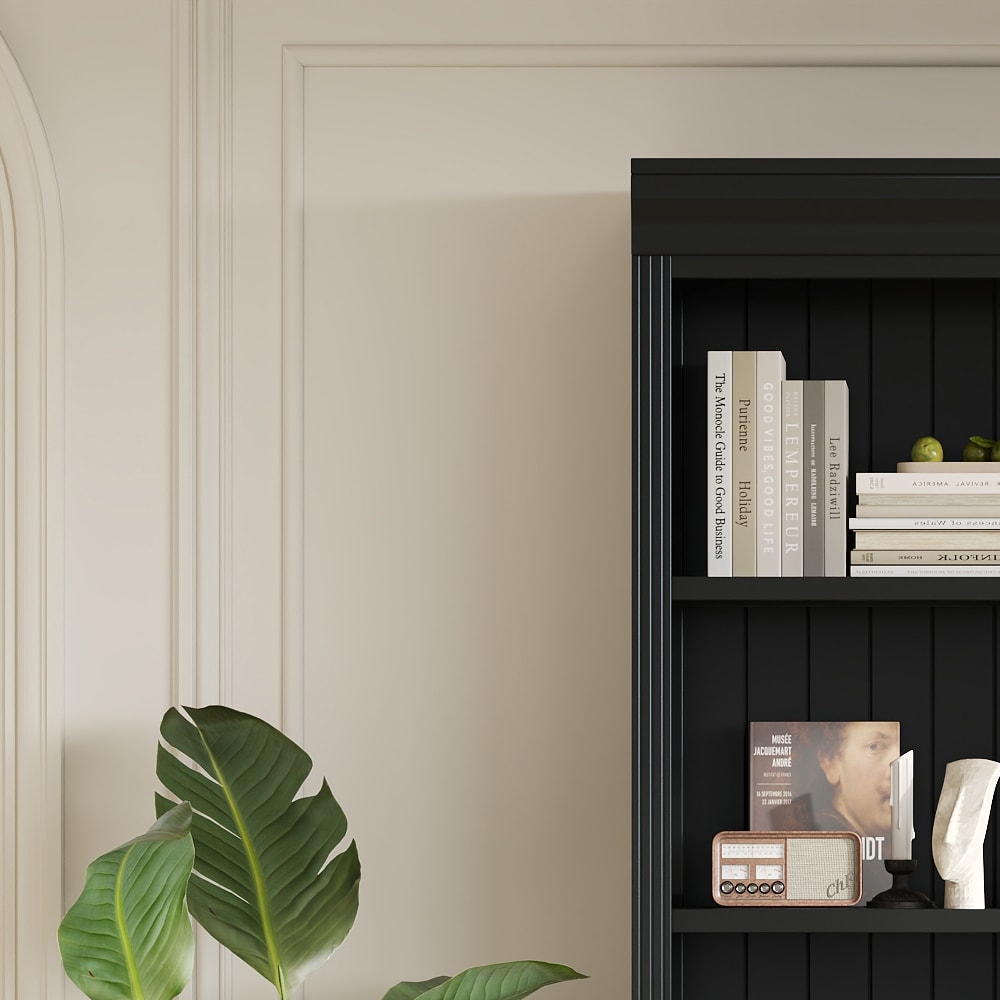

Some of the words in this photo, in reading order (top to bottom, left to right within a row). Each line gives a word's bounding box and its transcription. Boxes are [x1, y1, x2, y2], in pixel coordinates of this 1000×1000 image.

[715, 373, 726, 393] The
[715, 396, 726, 439] Monocle
[763, 383, 774, 424] GOOD
[739, 399, 751, 452] Purienne
[715, 441, 726, 471] Guide
[830, 437, 840, 458] Lee
[715, 474, 726, 485] to
[785, 424, 799, 553] LEMPEREUR
[830, 463, 840, 520] Radziwill
[715, 487, 726, 515] Good
[736, 481, 752, 528] Holiday
[763, 476, 774, 517] GOOD
[715, 518, 726, 560] Business
[763, 524, 774, 553] LIFE
[753, 746, 792, 756] JACQUEMART
[771, 733, 792, 744] MUSÉE
[772, 756, 792, 768] ANDRÉ
